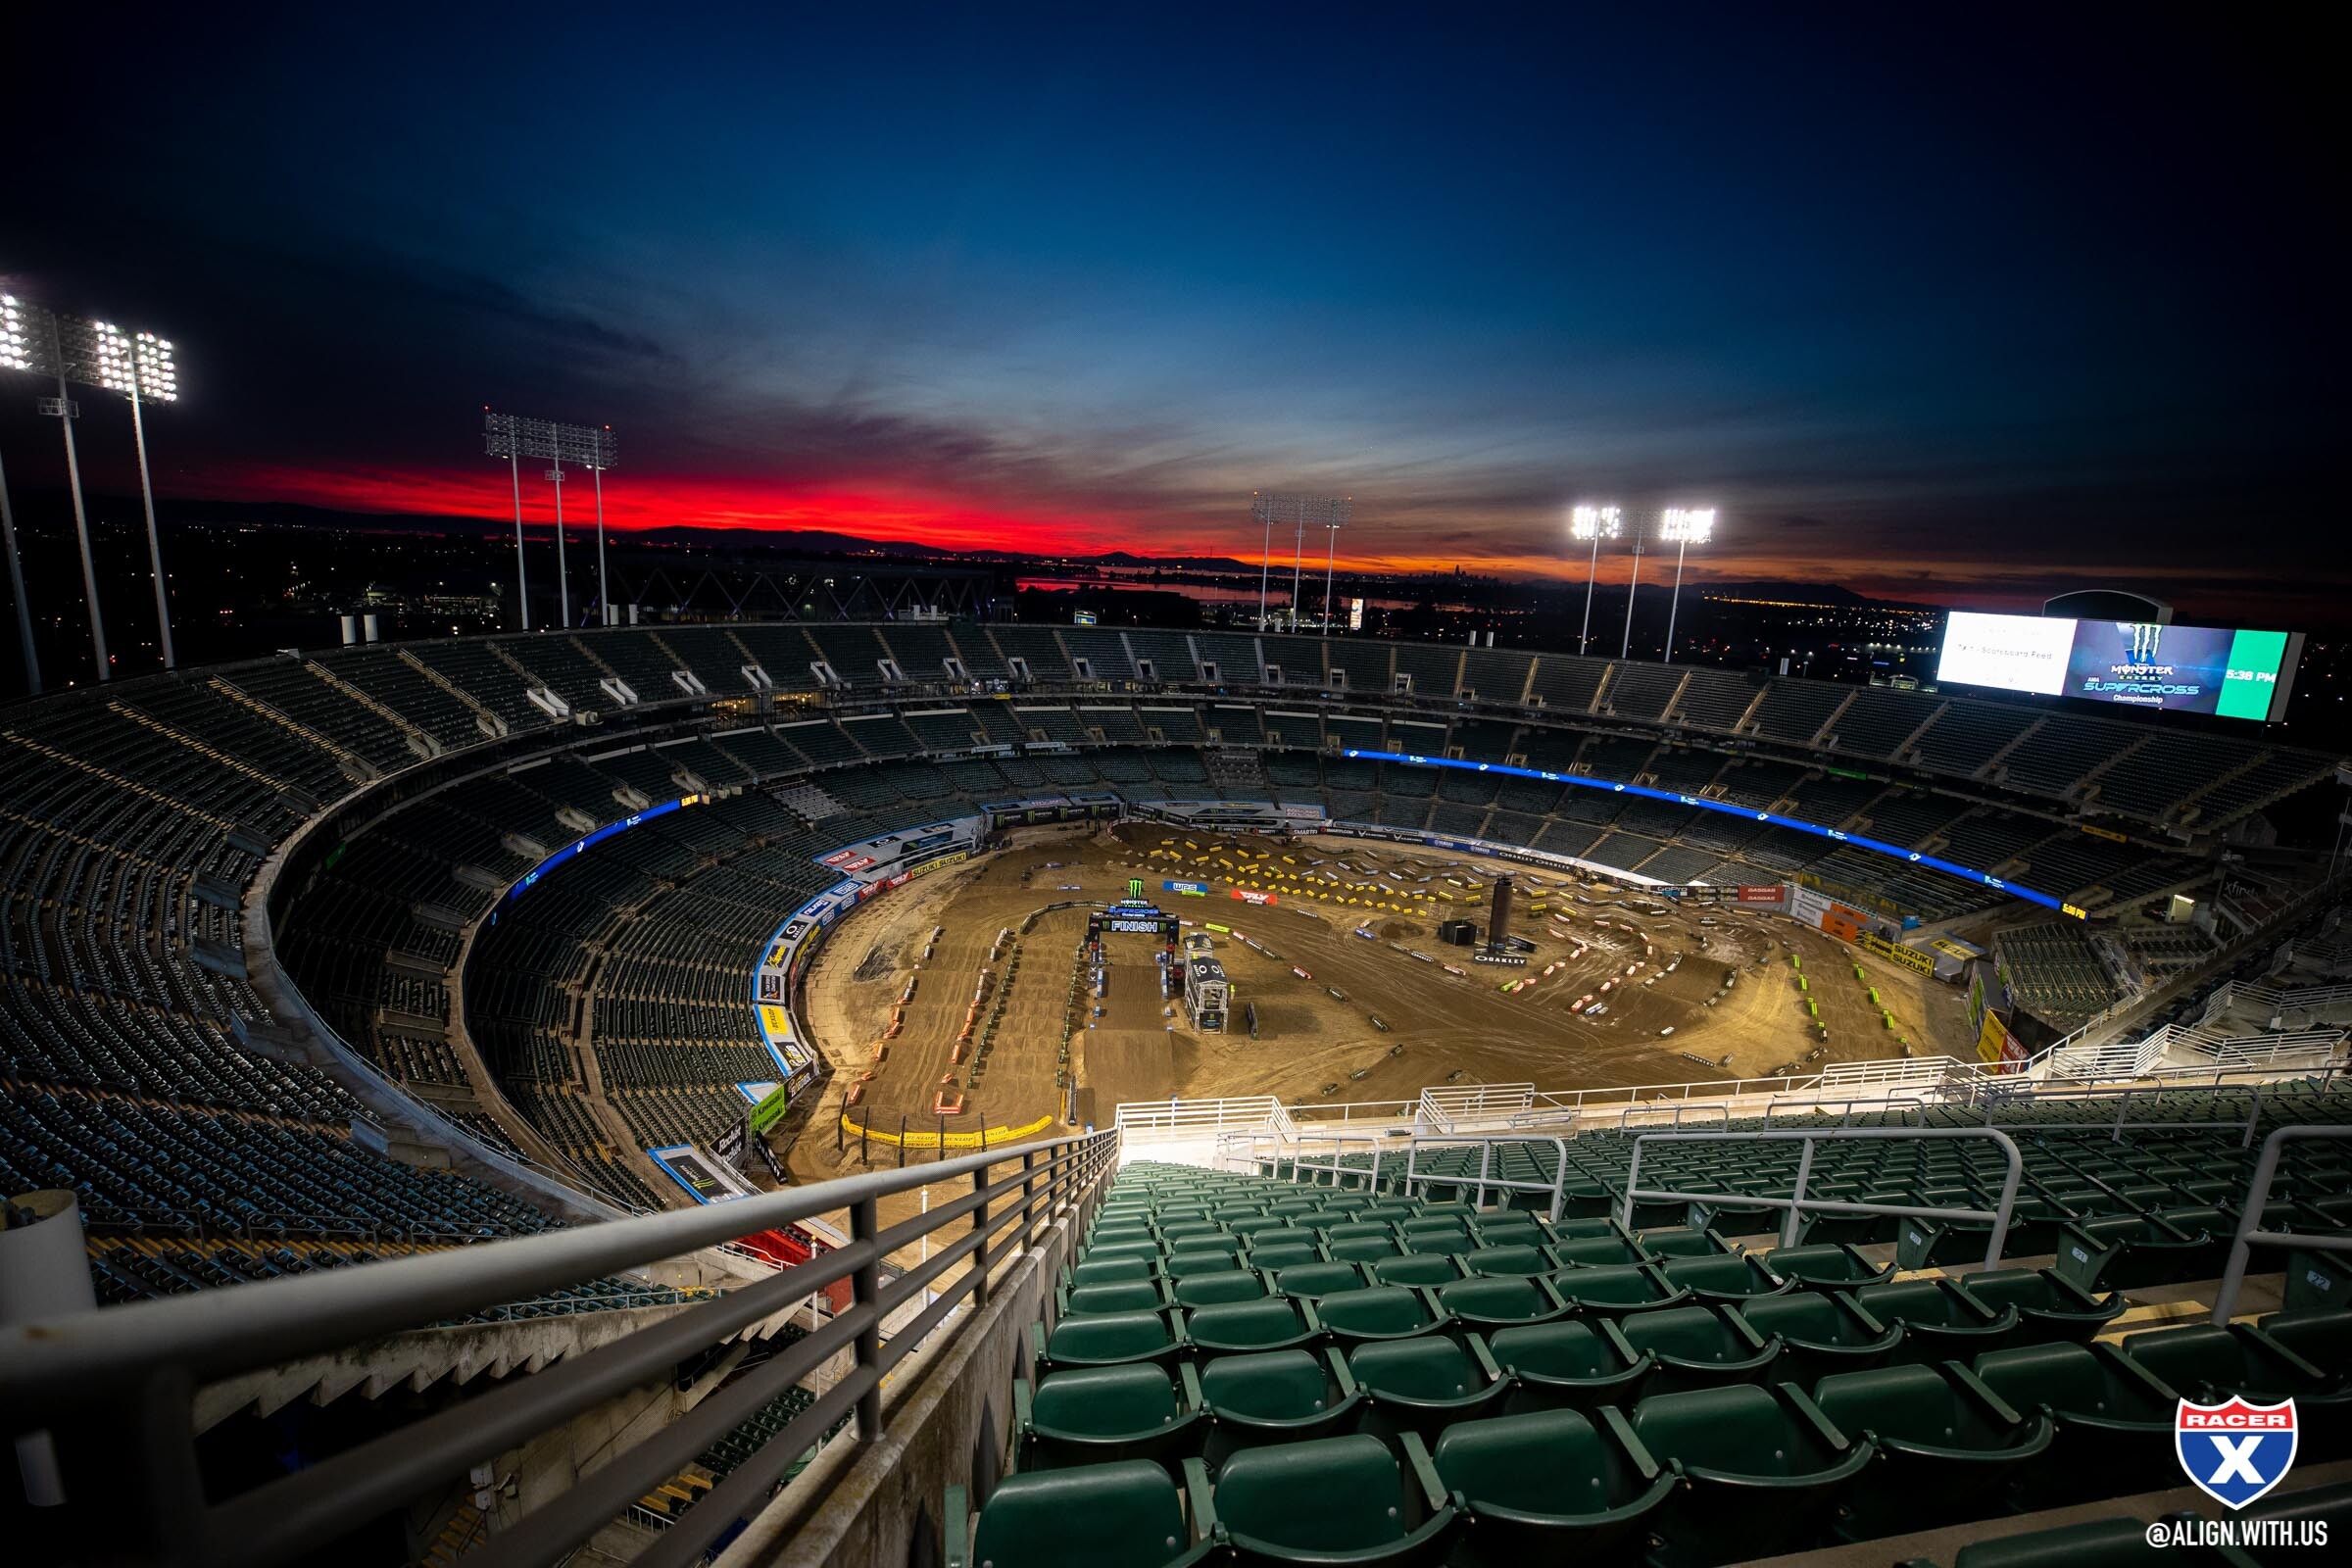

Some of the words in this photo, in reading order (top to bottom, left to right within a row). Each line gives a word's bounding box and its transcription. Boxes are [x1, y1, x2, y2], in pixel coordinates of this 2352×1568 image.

[2111, 664, 2173, 676] MONSTER
[2256, 671, 2277, 684] PM
[2083, 681, 2200, 696] SUPERCROSS
[2113, 694, 2163, 705] Championship
[939, 854, 965, 868] SUZUKI
[912, 863, 938, 878] SUZUKI
[1111, 920, 1158, 932] FINISH
[1893, 945, 1933, 966] SUZUKI
[1892, 954, 1931, 975] SUZUKI
[2313, 1274, 2328, 1287] 22
